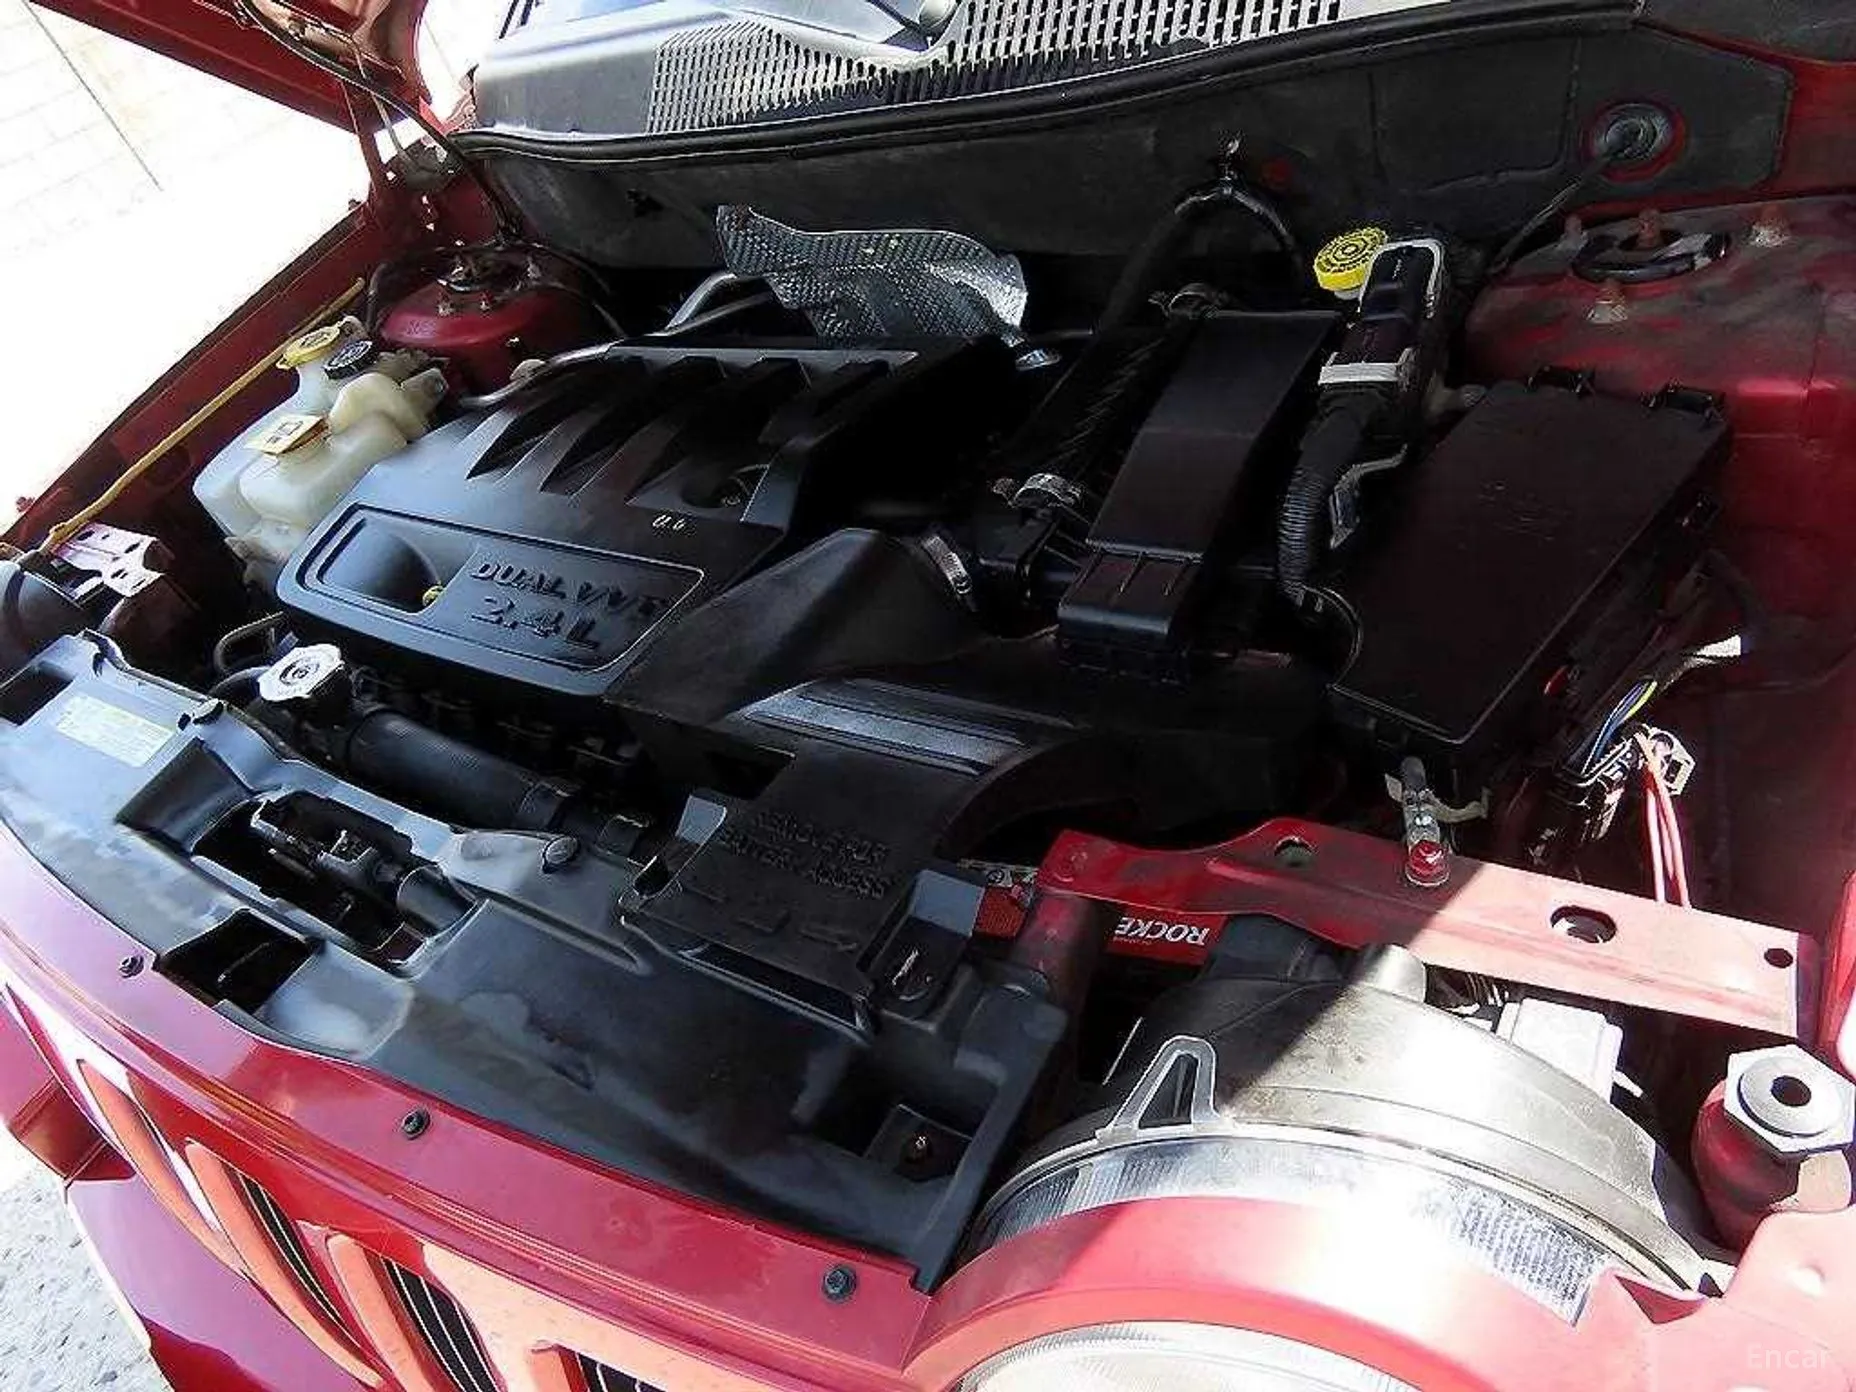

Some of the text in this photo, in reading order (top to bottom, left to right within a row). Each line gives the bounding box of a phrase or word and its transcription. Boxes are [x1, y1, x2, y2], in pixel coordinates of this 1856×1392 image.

[472, 562, 567, 598] DUAL
[472, 597, 601, 649] 2.4L
[1114, 916, 1211, 946] ROCKE
